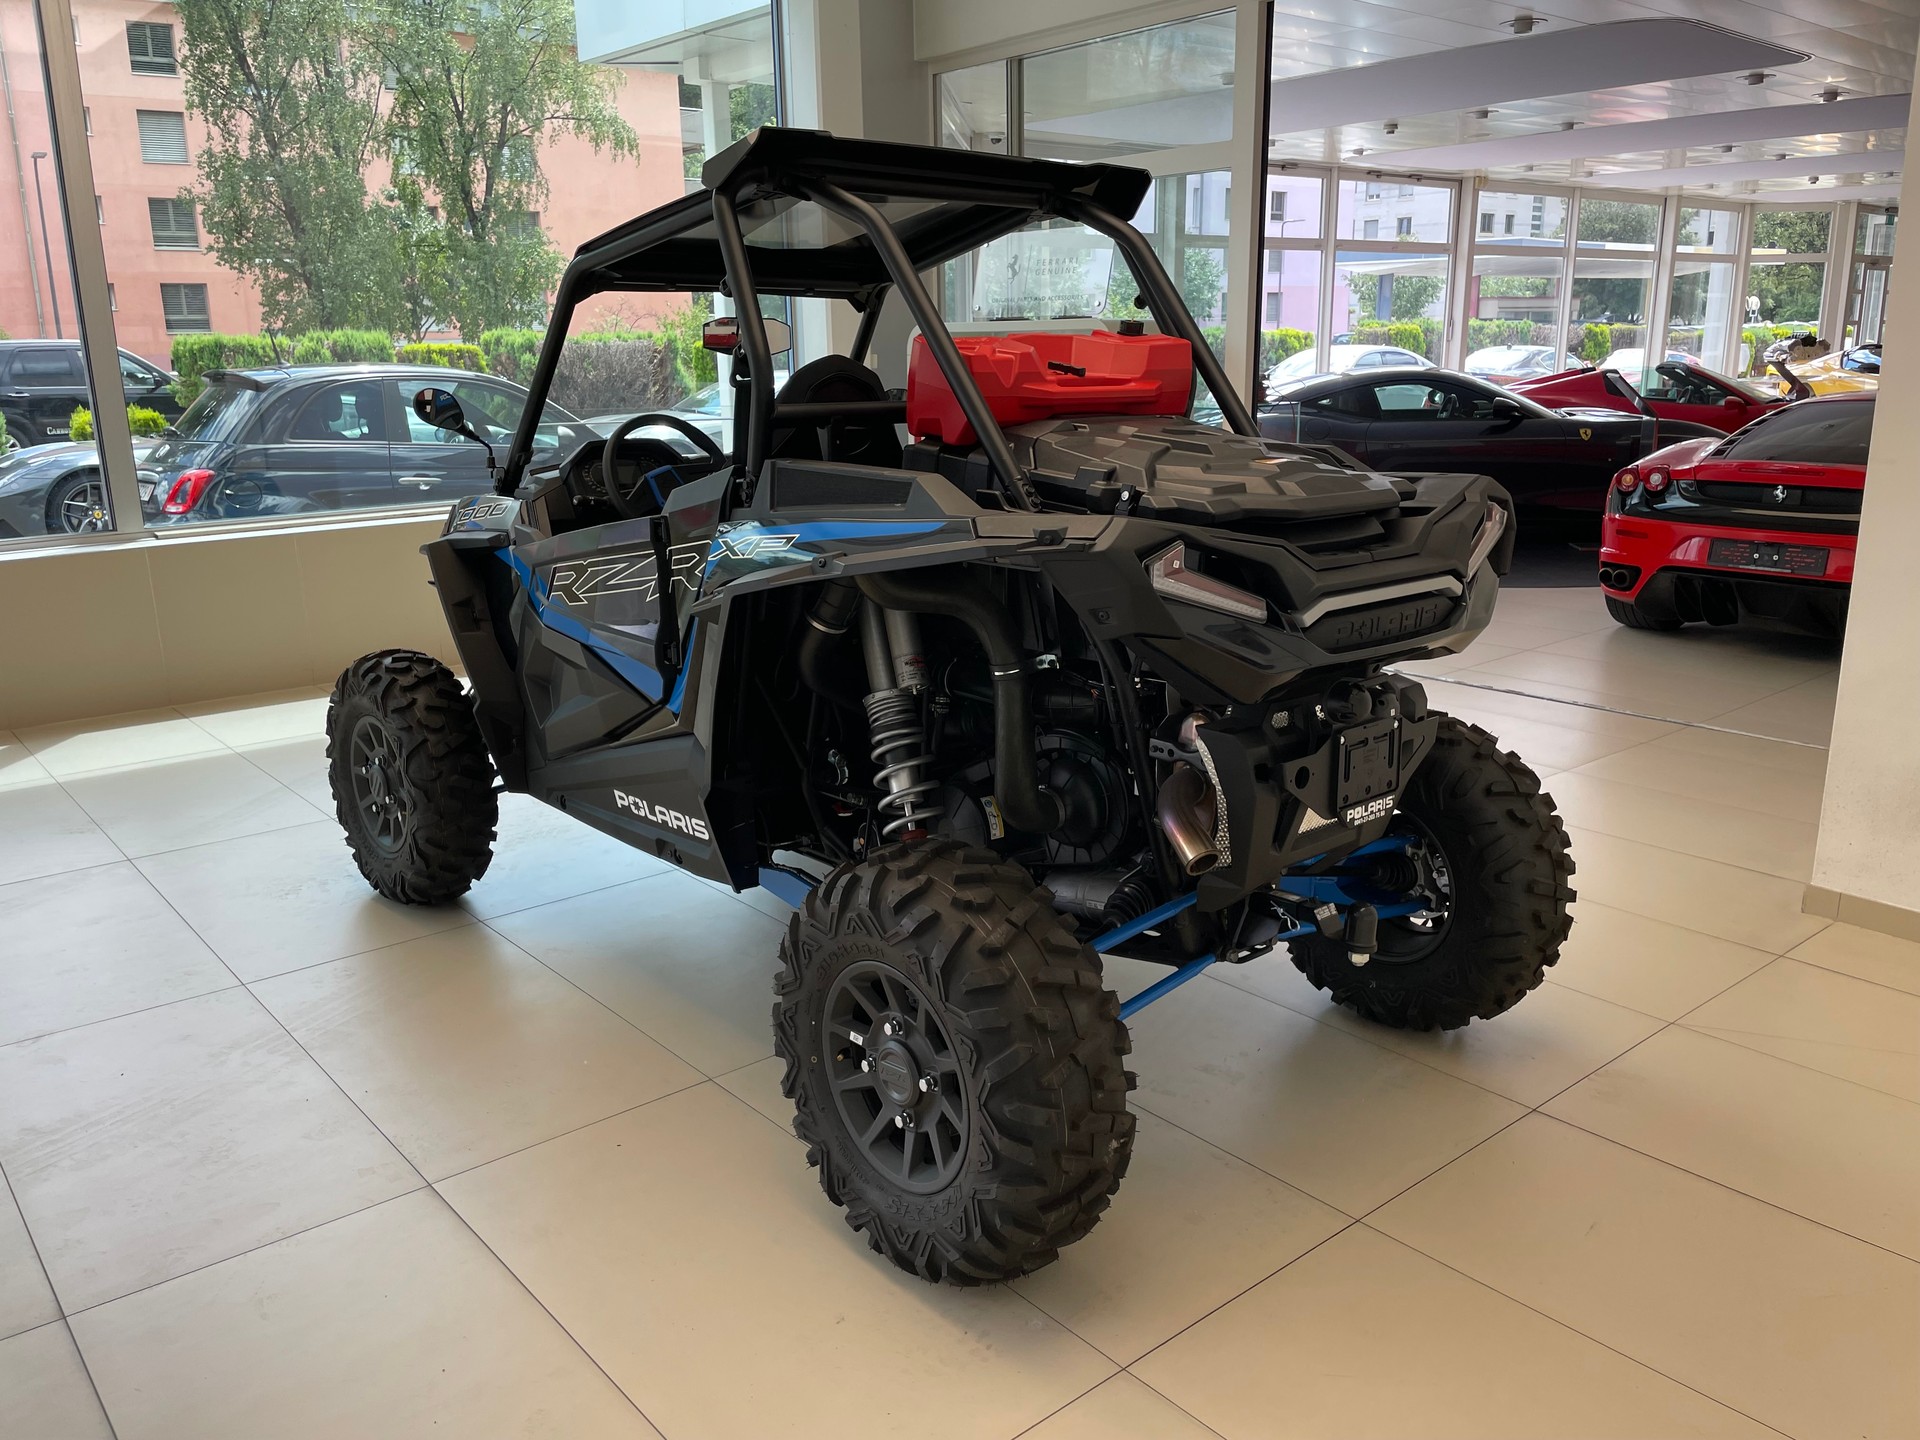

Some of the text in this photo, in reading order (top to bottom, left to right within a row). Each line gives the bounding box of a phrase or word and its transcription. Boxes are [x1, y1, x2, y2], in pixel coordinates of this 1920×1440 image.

[1035, 267, 1078, 276] GENUINE
[1036, 257, 1079, 266] FERRARI
[541, 533, 801, 610] RZR XP
[613, 788, 710, 840] POLARIS
[1346, 796, 1395, 822] POLARIS
